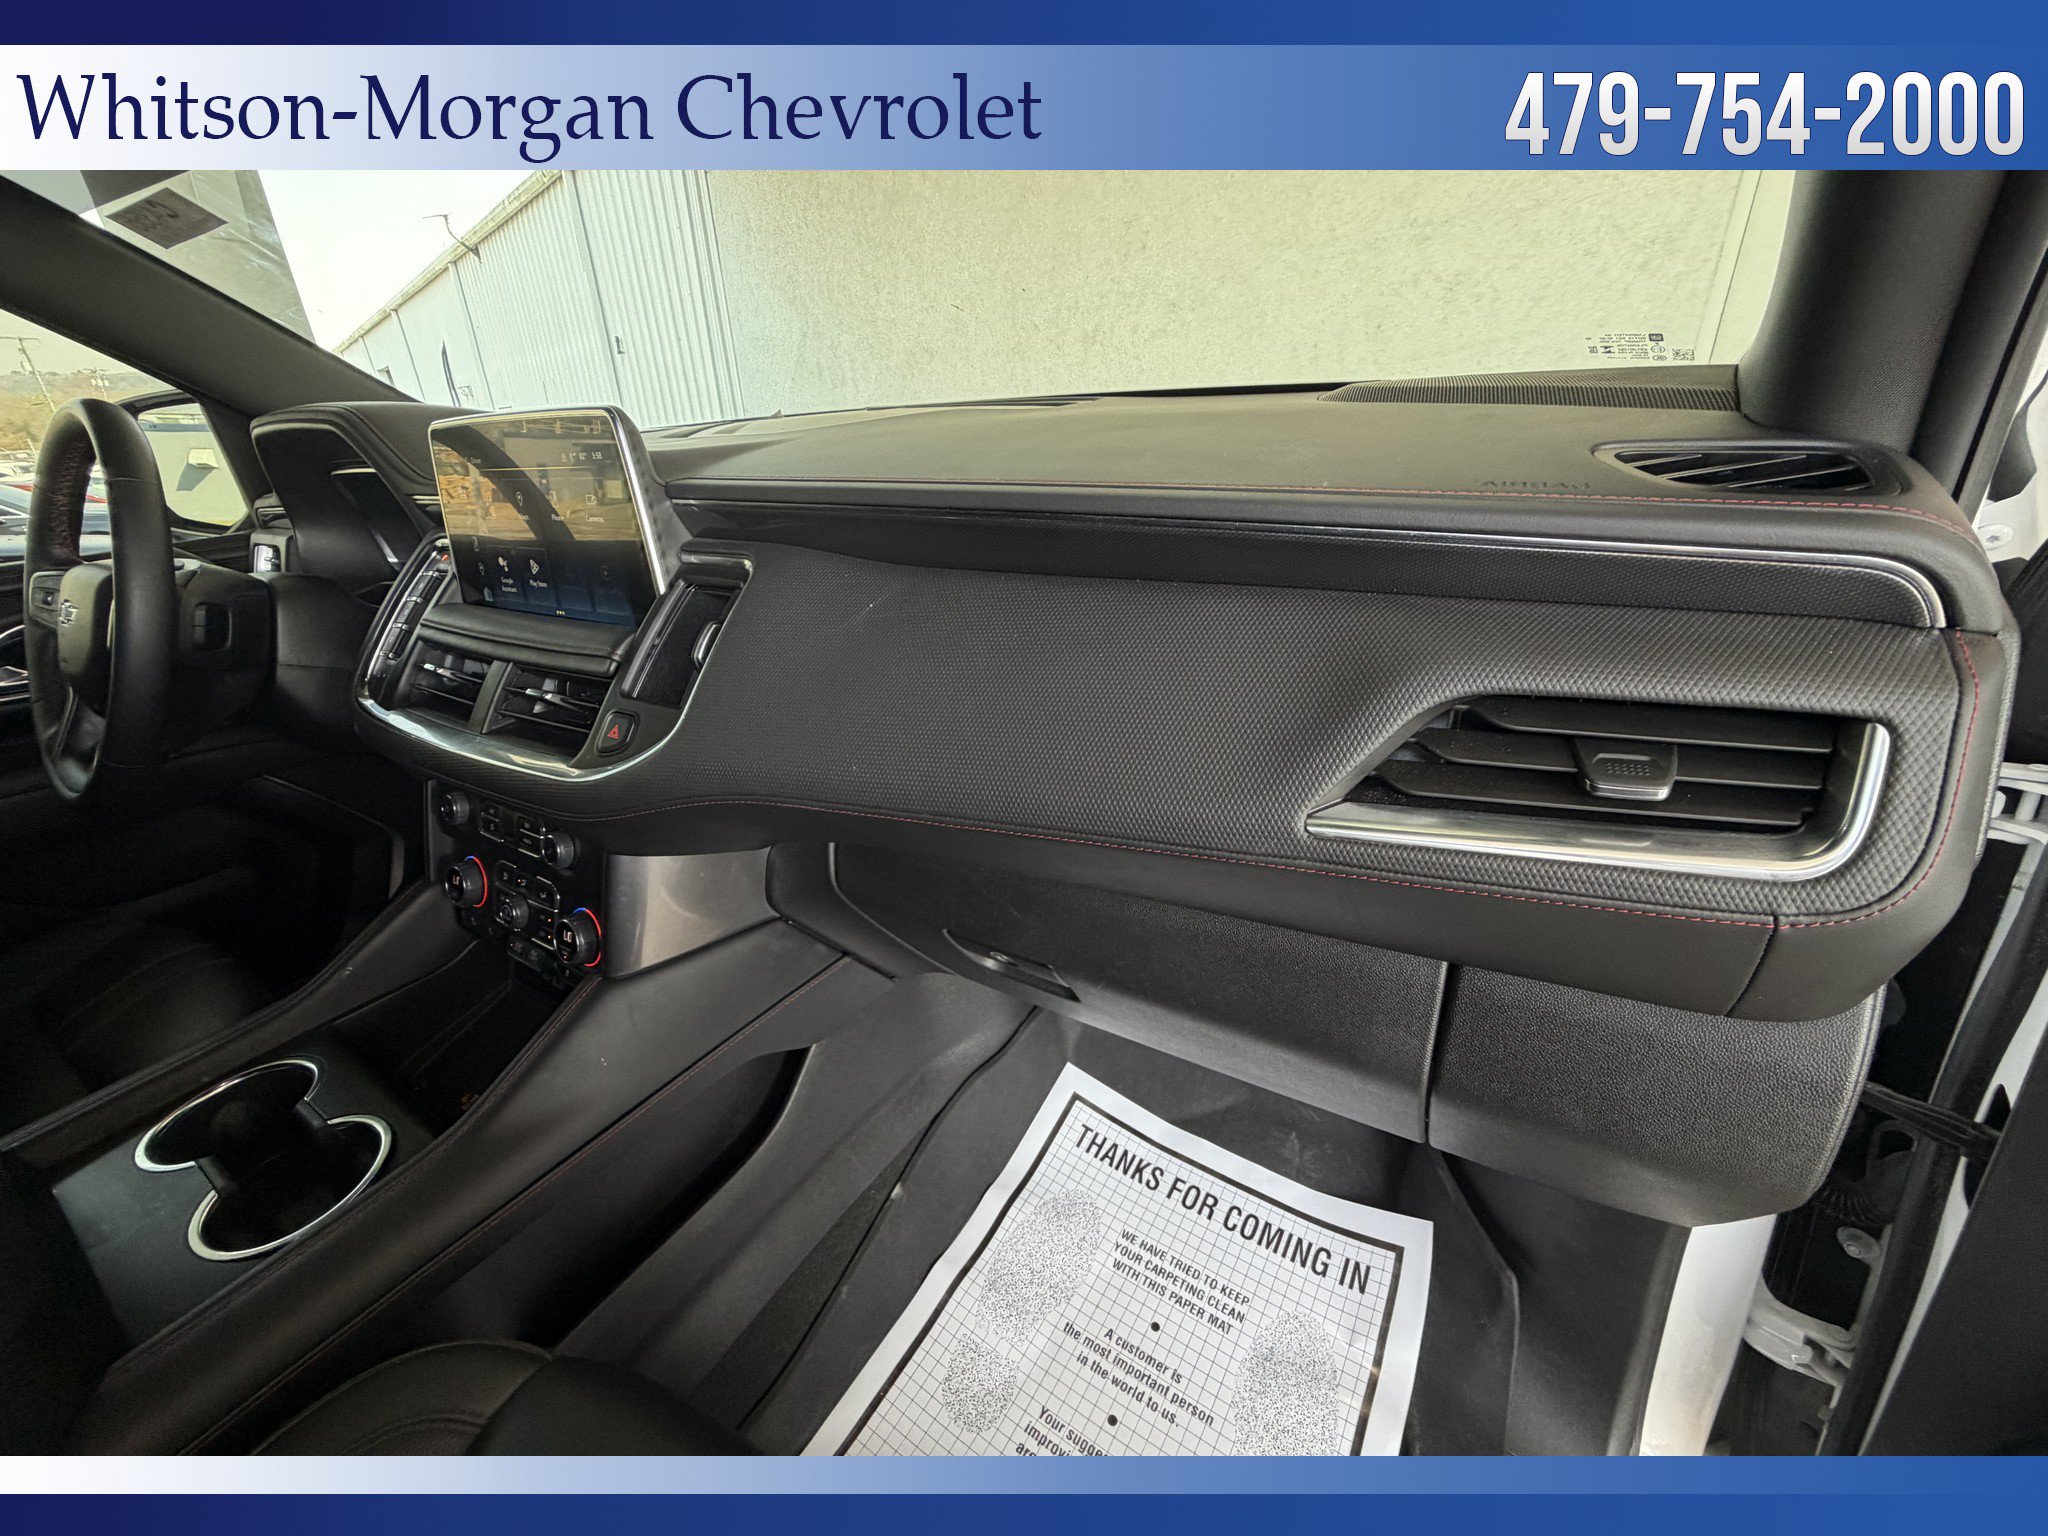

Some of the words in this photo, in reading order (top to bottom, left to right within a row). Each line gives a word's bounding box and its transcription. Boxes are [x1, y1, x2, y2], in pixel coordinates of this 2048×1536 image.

[1076, 1123, 1165, 1191] THANKS
[1166, 1176, 1219, 1221] FOR
[1223, 1205, 1332, 1278] COMING
[1338, 1257, 1371, 1295] IN
[1112, 1258, 1141, 1281] WITH
[1142, 1274, 1168, 1297] THIS
[1168, 1290, 1206, 1320] PAPER
[1207, 1313, 1234, 1336] MAT
[1114, 1241, 1144, 1265] YOUR
[1144, 1260, 1206, 1302] CARPETING
[1207, 1295, 1246, 1324] CLEAN
[1121, 1229, 1139, 1246] WE
[1140, 1239, 1168, 1261] HAVE
[1169, 1255, 1201, 1280] TRIED
[1203, 1274, 1218, 1290] TO
[1220, 1284, 1250, 1306] KEEP
[1063, 1322, 1082, 1340] the
[1083, 1336, 1112, 1360] most
[1112, 1353, 1170, 1398] important
[1170, 1392, 1215, 1426] person
[1076, 1350, 1089, 1367] in
[1090, 1360, 1109, 1380] the
[1111, 1374, 1145, 1403] world
[1146, 1396, 1159, 1413] to
[1162, 1408, 1179, 1427] us.
[1104, 1328, 1114, 1341] A
[1115, 1336, 1170, 1376] customer
[1171, 1368, 1182, 1384] is
[1039, 1406, 1066, 1433] Your
[1066, 1429, 1108, 1456] sugge
